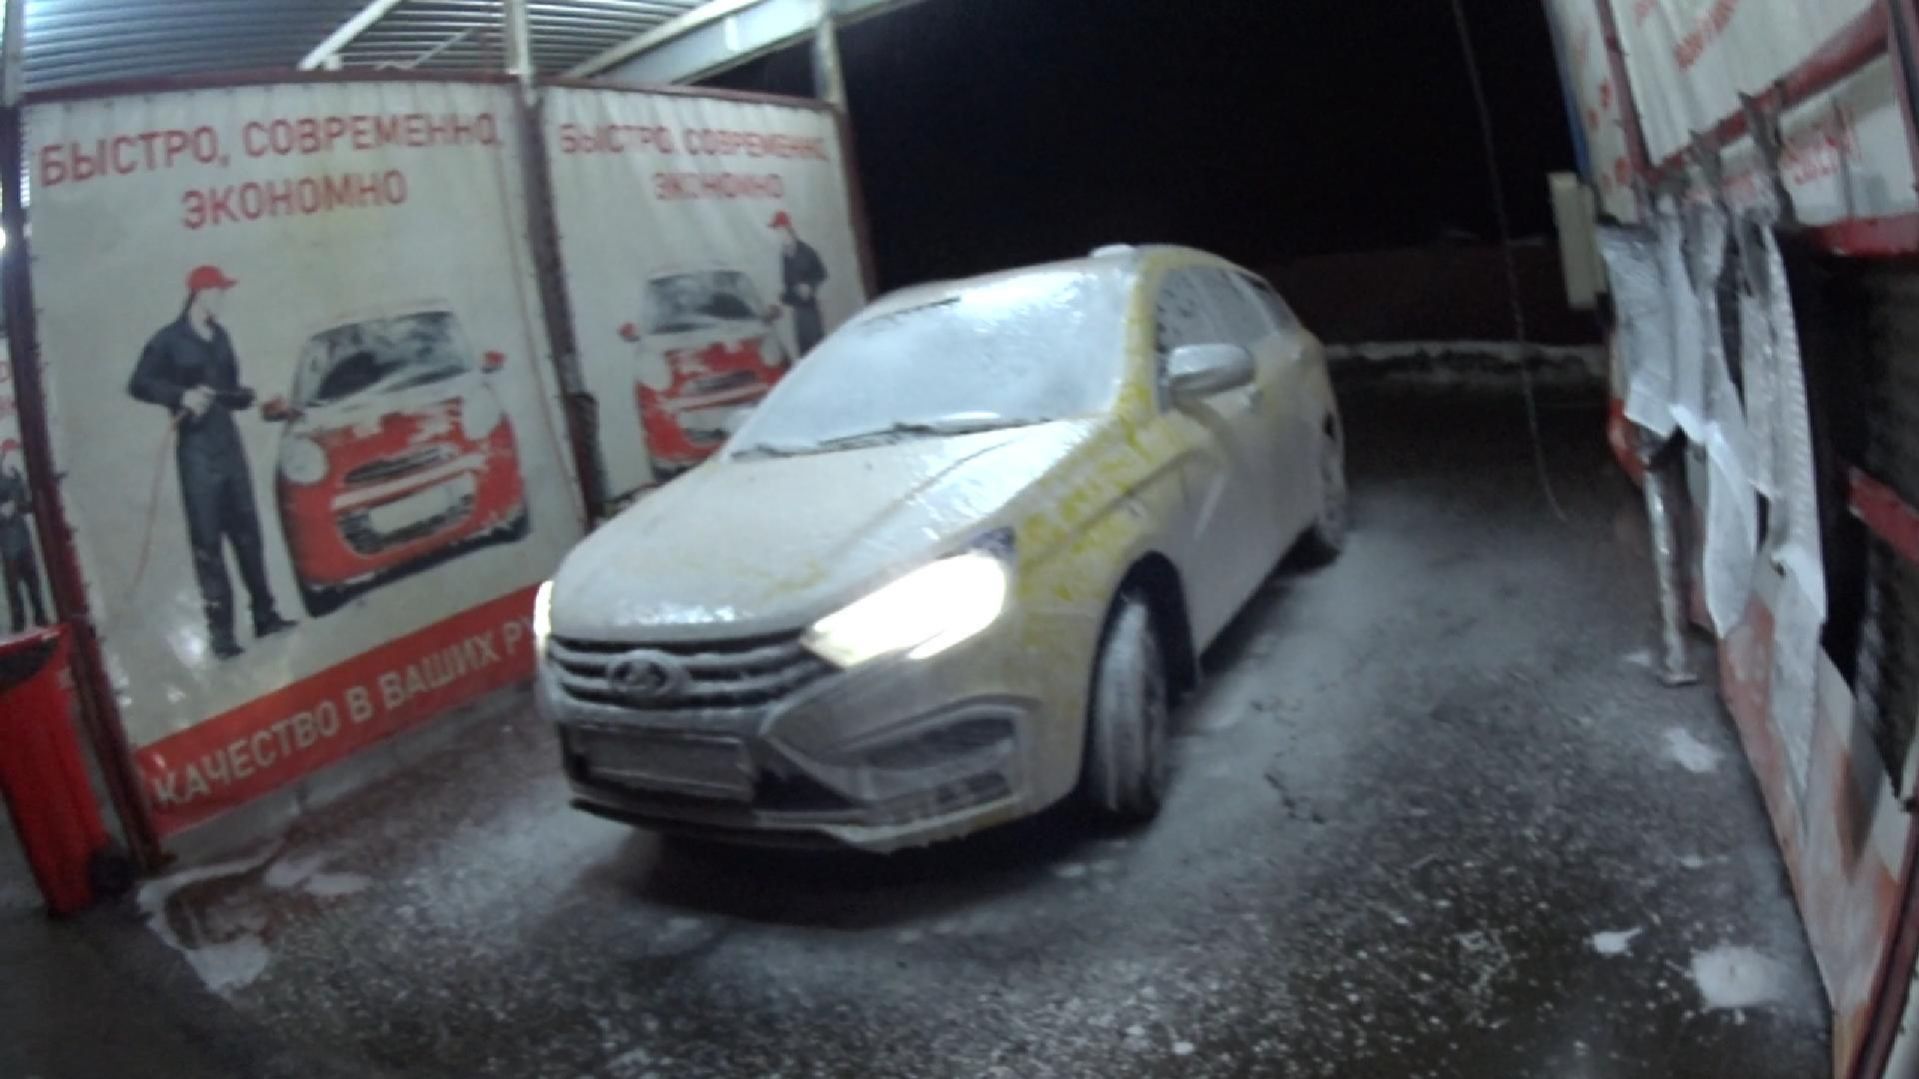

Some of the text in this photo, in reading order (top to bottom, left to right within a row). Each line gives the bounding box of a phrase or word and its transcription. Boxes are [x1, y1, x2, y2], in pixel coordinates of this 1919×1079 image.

[39, 125, 231, 187] БЫСТРО,
[655, 171, 783, 199] ЭКОНОМНО
[182, 169, 408, 230] ЭКОНОМНО
[151, 701, 339, 805] КАЧЕСТВО
[344, 684, 373, 724] В
[377, 629, 500, 711] ВАШИХ
